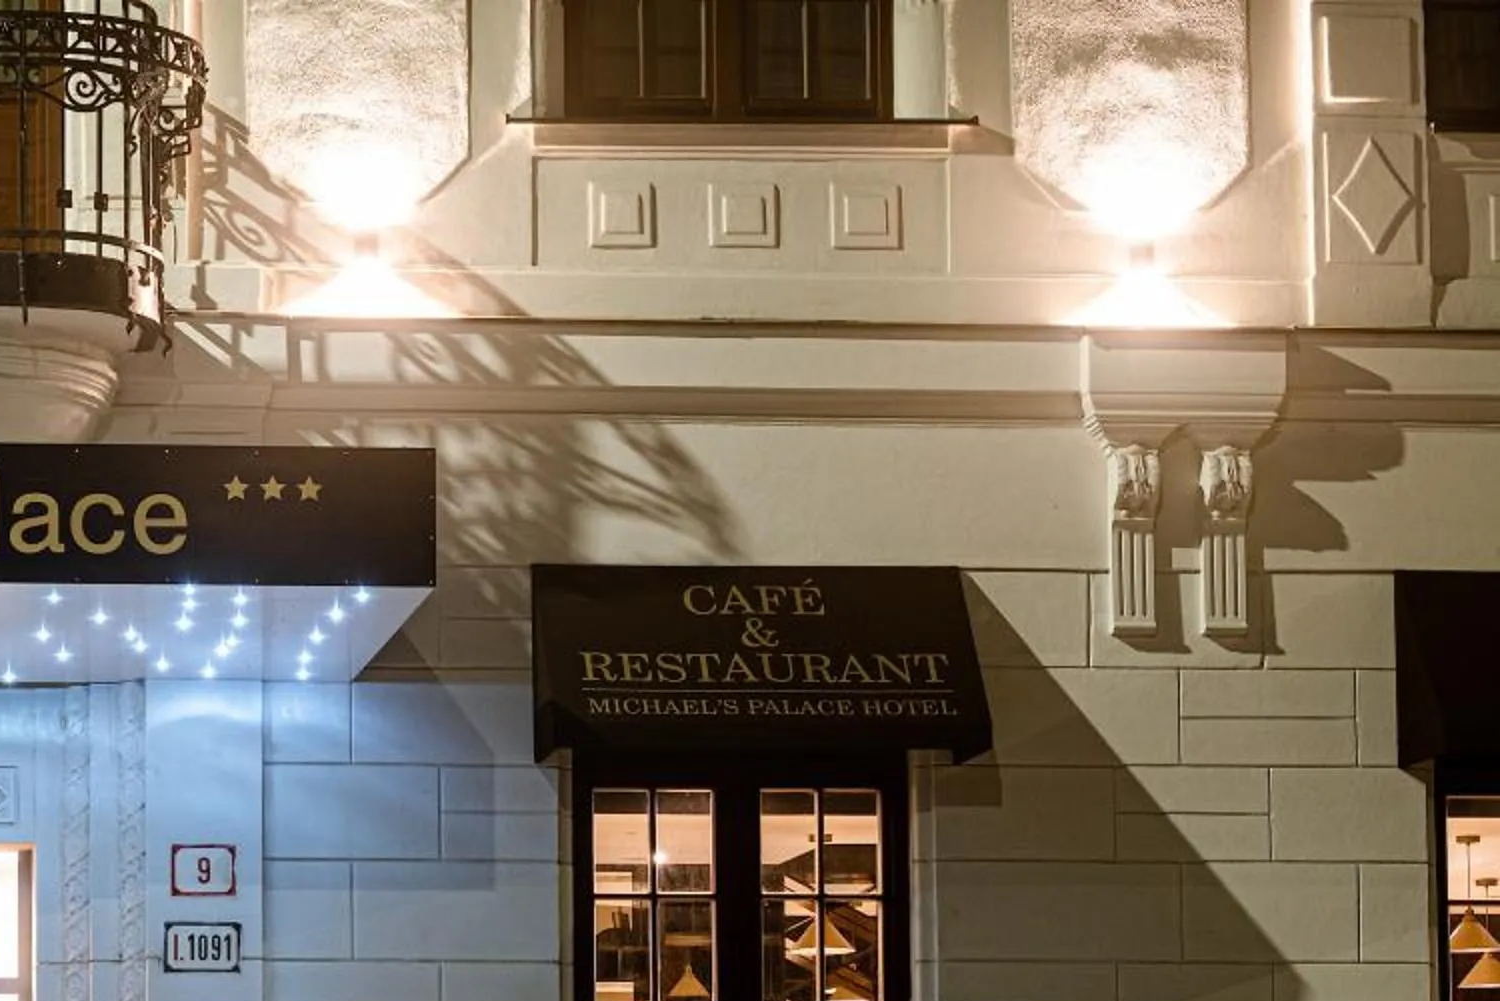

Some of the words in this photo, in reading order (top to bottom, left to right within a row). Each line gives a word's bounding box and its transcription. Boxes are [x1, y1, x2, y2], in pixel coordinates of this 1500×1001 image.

[682, 577, 826, 616] CAFÉ
[739, 616, 780, 648] &
[579, 651, 950, 684] RESTAURANT
[587, 696, 741, 716] MICHAEL'S
[747, 698, 856, 716] PALACE
[862, 699, 959, 717] HOTEL
[197, 857, 211, 884] 9
